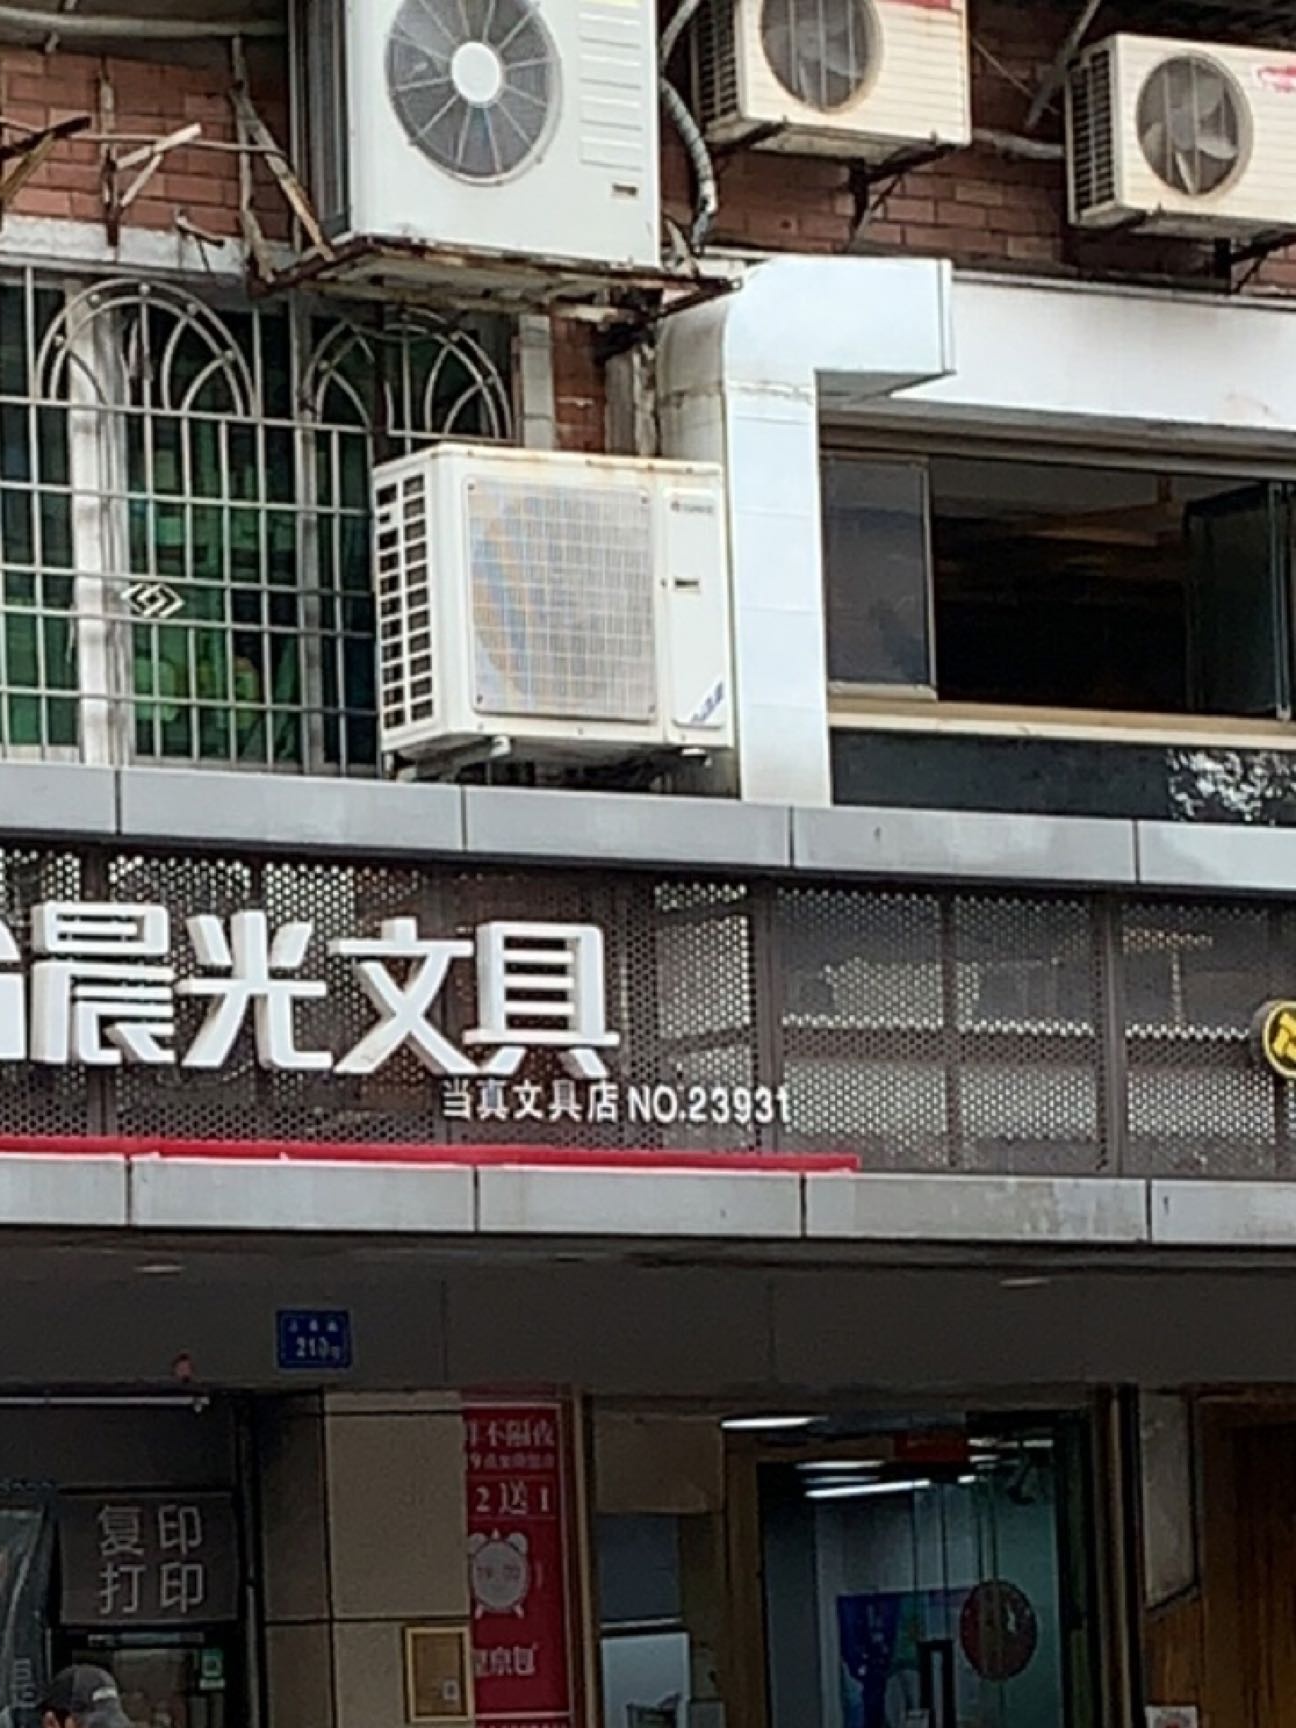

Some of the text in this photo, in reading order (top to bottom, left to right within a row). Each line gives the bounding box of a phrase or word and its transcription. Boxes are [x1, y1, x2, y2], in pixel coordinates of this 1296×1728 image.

[29, 900, 621, 1081] 晨光文具
[442, 1079, 791, 1124] 当真文具店 NO.23931
[99, 1504, 203, 1556] 复印
[99, 1561, 204, 1615] 打印
